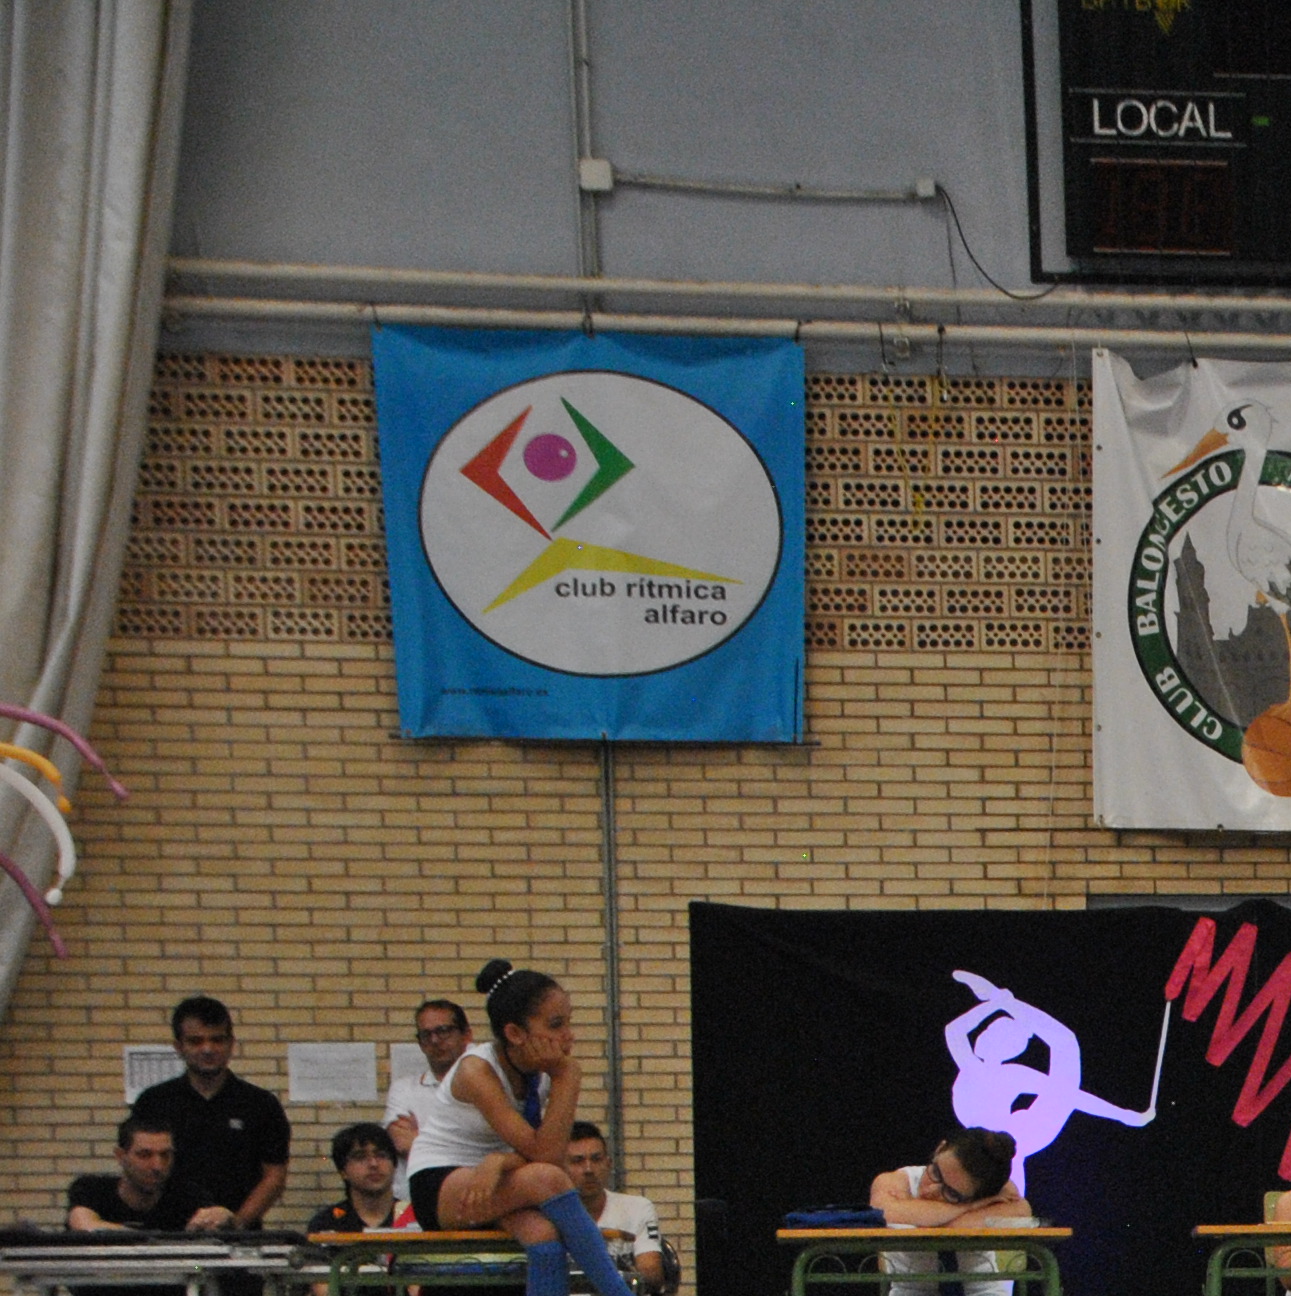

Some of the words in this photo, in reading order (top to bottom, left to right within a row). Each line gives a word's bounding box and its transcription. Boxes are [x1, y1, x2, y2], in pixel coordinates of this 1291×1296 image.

[1092, 98, 1233, 139] LOCAL
[555, 576, 615, 598] club
[644, 603, 728, 626] alfaro
[1156, 666, 1223, 742] CLUB
